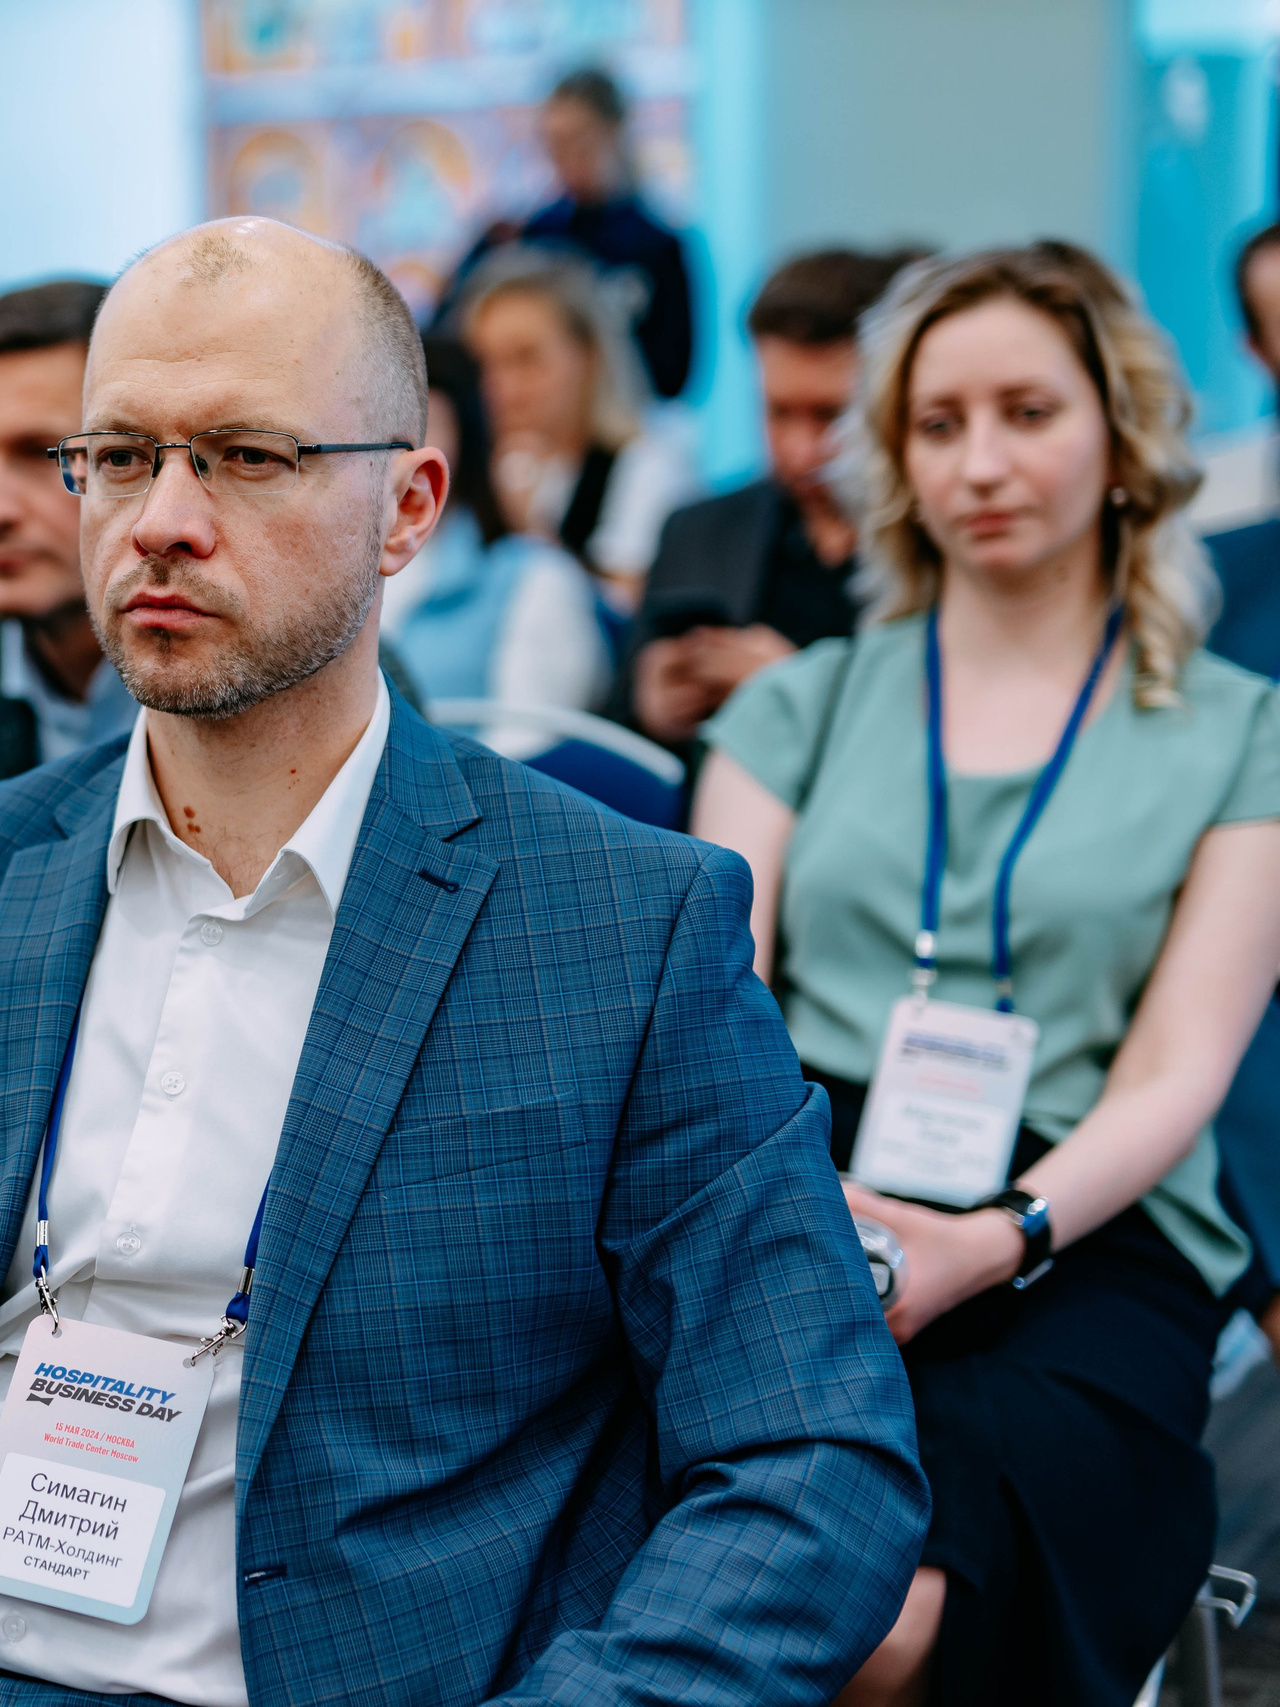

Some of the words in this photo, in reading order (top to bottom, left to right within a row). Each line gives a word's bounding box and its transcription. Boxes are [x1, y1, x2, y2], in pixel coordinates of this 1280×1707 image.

[29, 1377, 135, 1413] BUSINESS
[135, 1402, 183, 1423] DAY
[34, 1362, 177, 1404] HOSPITALITY
[44, 1432, 64, 1445] World
[65, 1437, 85, 1450] Trade
[85, 1442, 110, 1456] Center
[110, 1448, 139, 1463] Moscow
[55, 1421, 64, 1431] 15
[64, 1424, 80, 1435] МАЯ
[81, 1427, 99, 1440] 2024
[106, 1434, 135, 1449] МОСКВА
[30, 1473, 127, 1513] Симагин
[18, 1500, 120, 1540] Дмитрий
[2, 1526, 123, 1569] РАТМ-Холдинг
[23, 1555, 91, 1581] СТАНДАРТ
